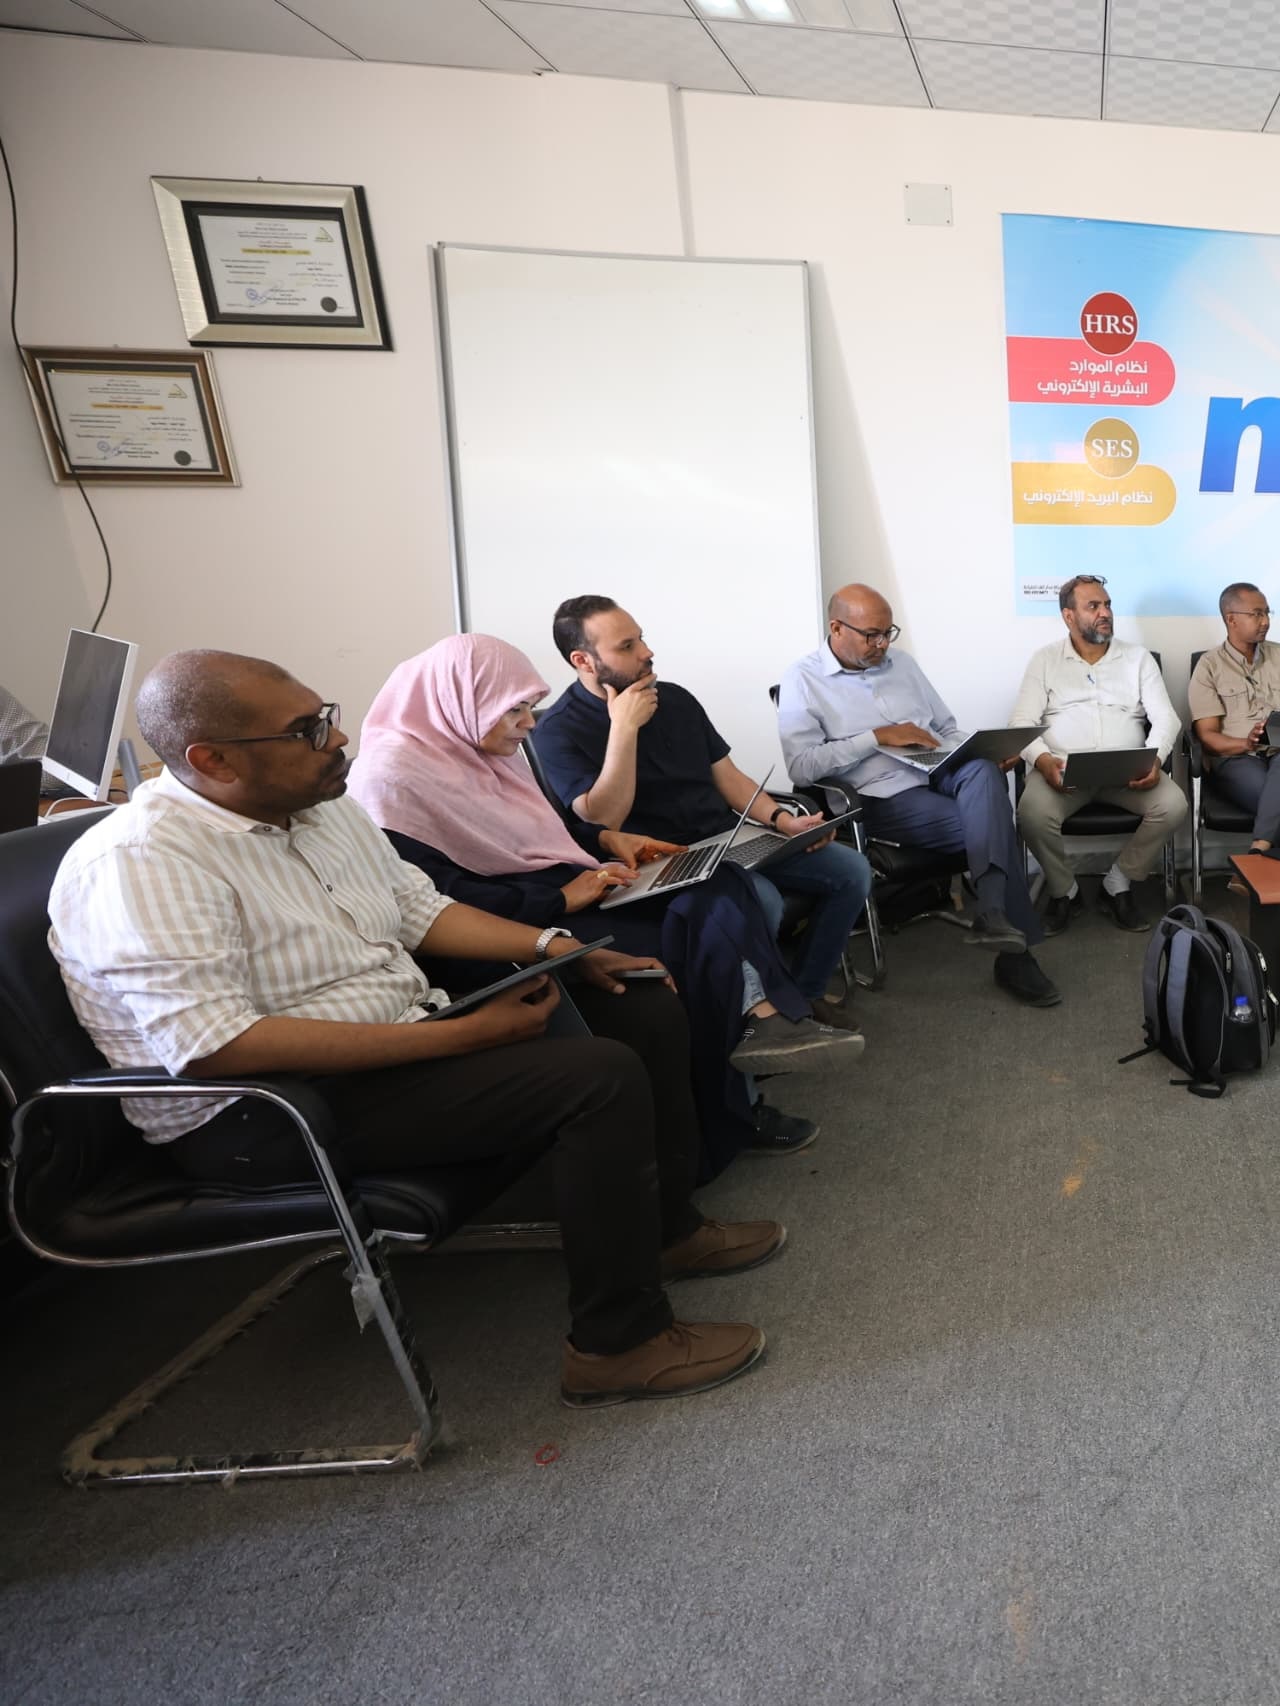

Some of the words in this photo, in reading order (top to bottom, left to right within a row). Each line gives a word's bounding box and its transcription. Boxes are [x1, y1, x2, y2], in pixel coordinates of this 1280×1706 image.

[1084, 313, 1135, 336] HRS
[1069, 359, 1113, 375] الموارد
[1115, 360, 1148, 376] نظام
[1037, 378, 1100, 399] الإلكتروني
[1102, 379, 1148, 398] البشرية
[1091, 438, 1133, 459] SES
[1023, 488, 1084, 508] الإلكتروني
[1087, 491, 1119, 506] البريد
[1121, 490, 1153, 506] نظام
